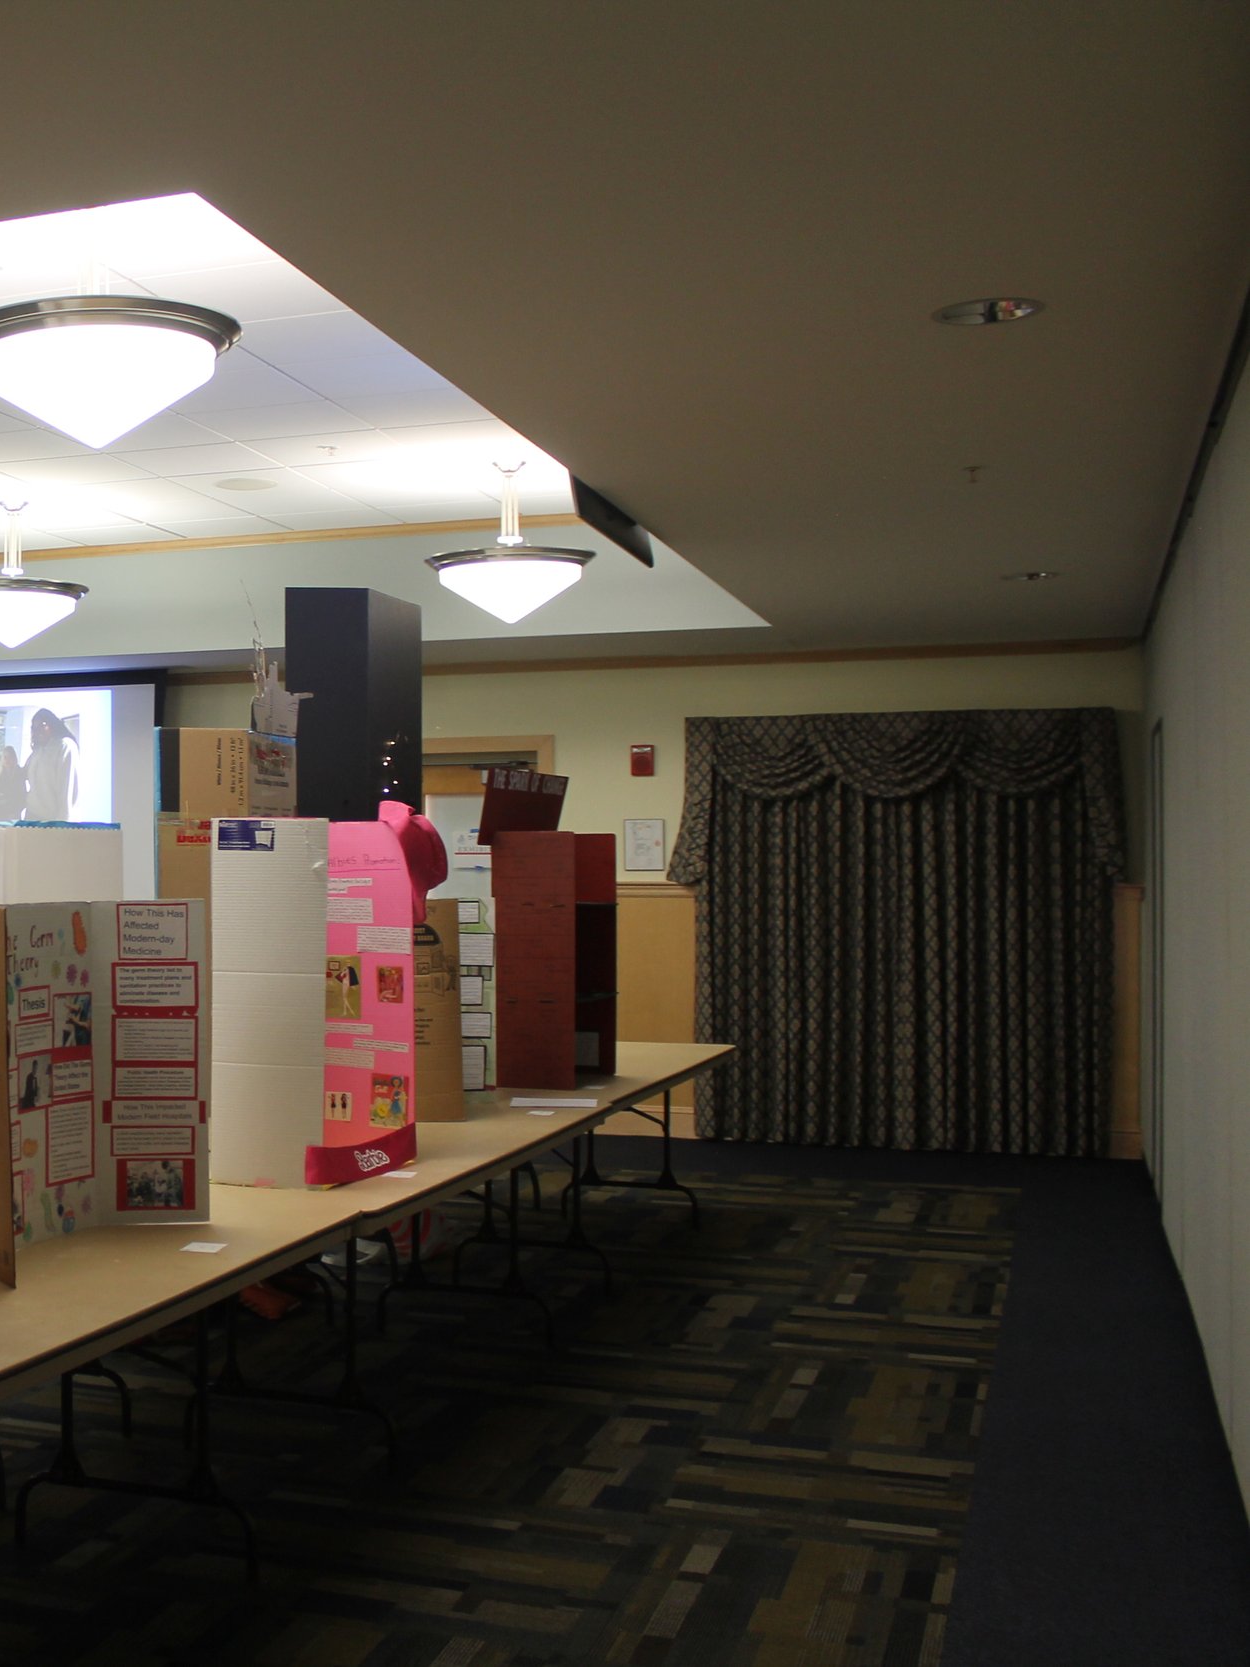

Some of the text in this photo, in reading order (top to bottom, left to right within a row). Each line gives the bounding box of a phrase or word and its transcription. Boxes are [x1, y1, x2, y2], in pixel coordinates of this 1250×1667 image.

[494, 768, 507, 789] THE
[146, 909, 165, 917] This
[167, 910, 184, 918] Has
[123, 921, 159, 930] Affected
[123, 934, 175, 944] Modern-day
[123, 946, 162, 955] Medicine
[22, 997, 46, 1011] Thesis
[354, 1149, 390, 1171] Barbie
